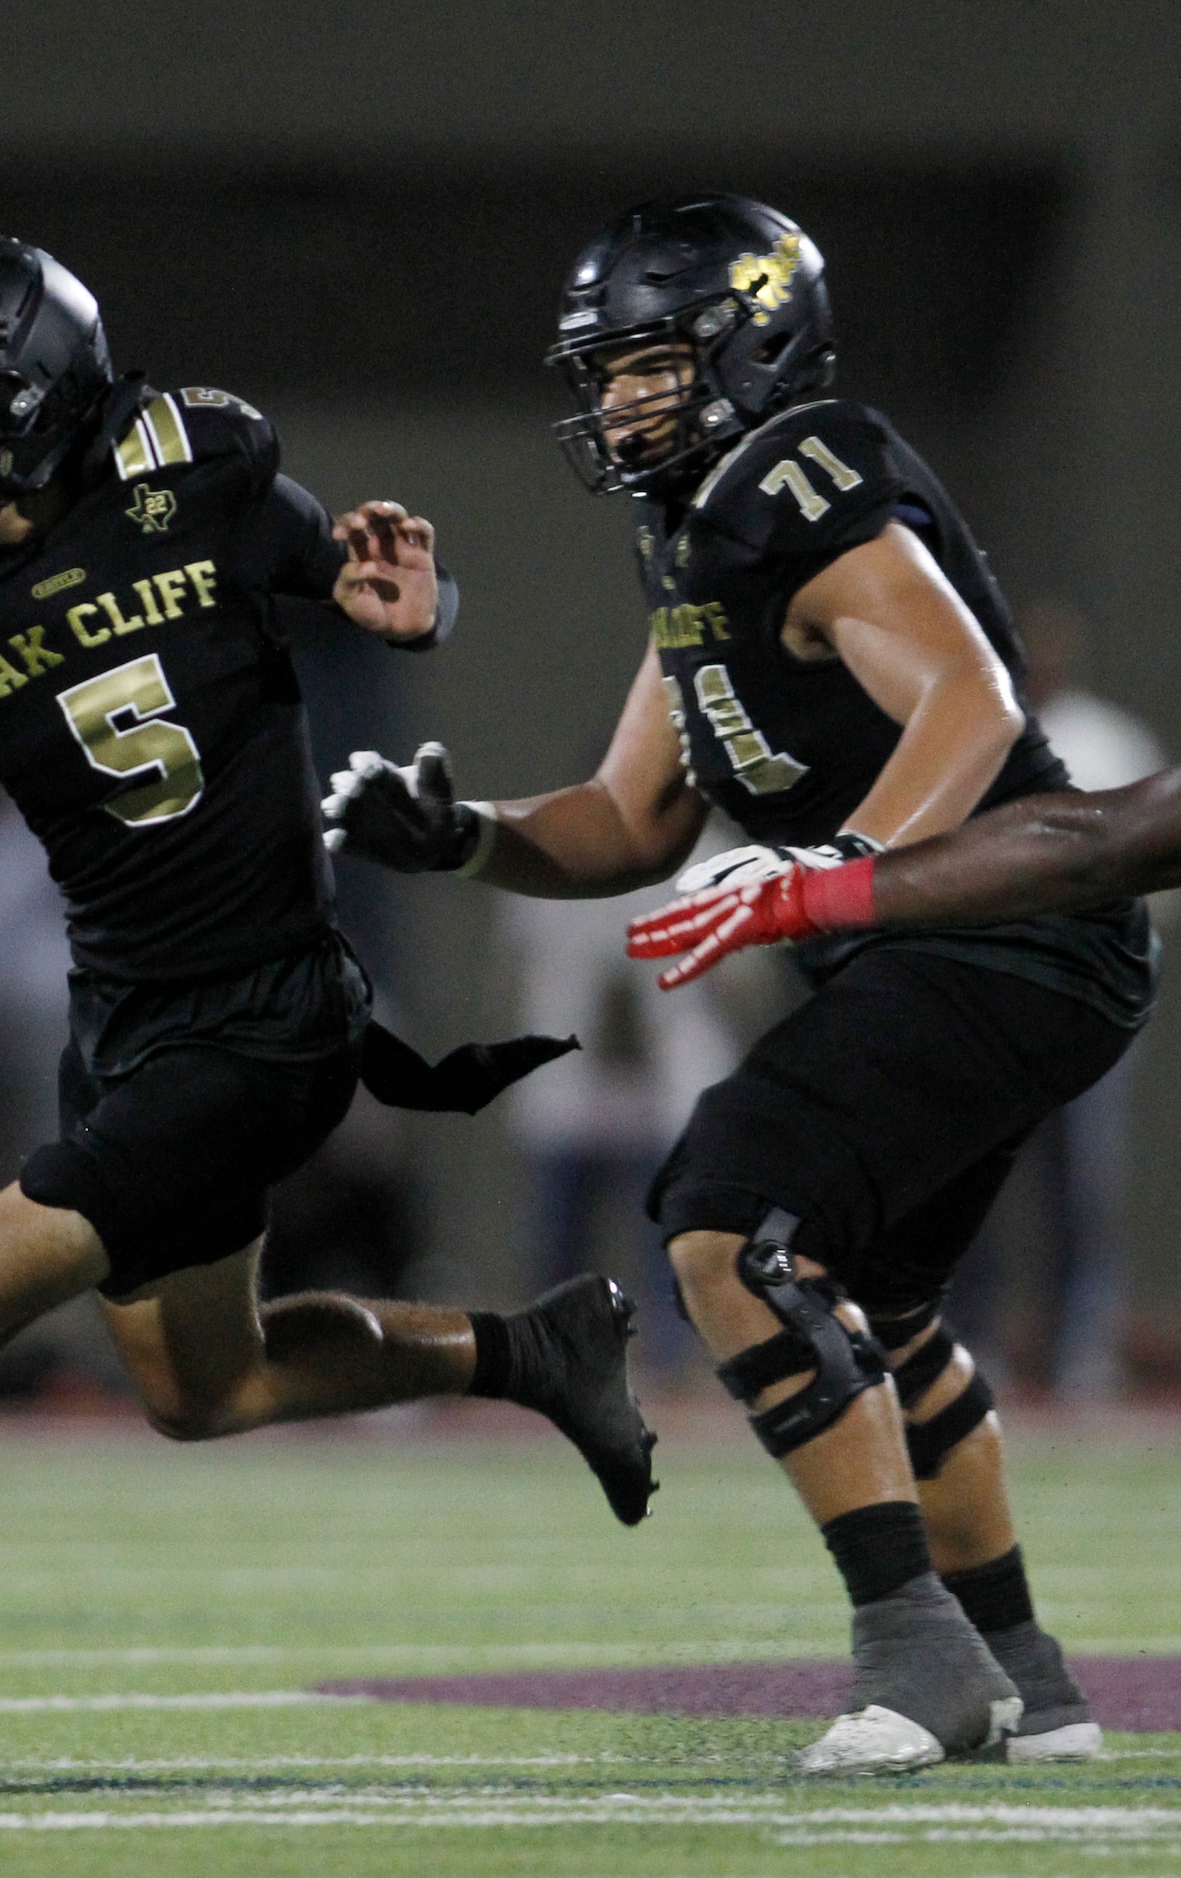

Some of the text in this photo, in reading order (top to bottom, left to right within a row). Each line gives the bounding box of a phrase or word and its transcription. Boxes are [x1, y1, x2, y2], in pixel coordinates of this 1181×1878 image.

[758, 435, 864, 522] 71
[66, 558, 217, 648] CLIFF
[55, 652, 206, 829] 5
